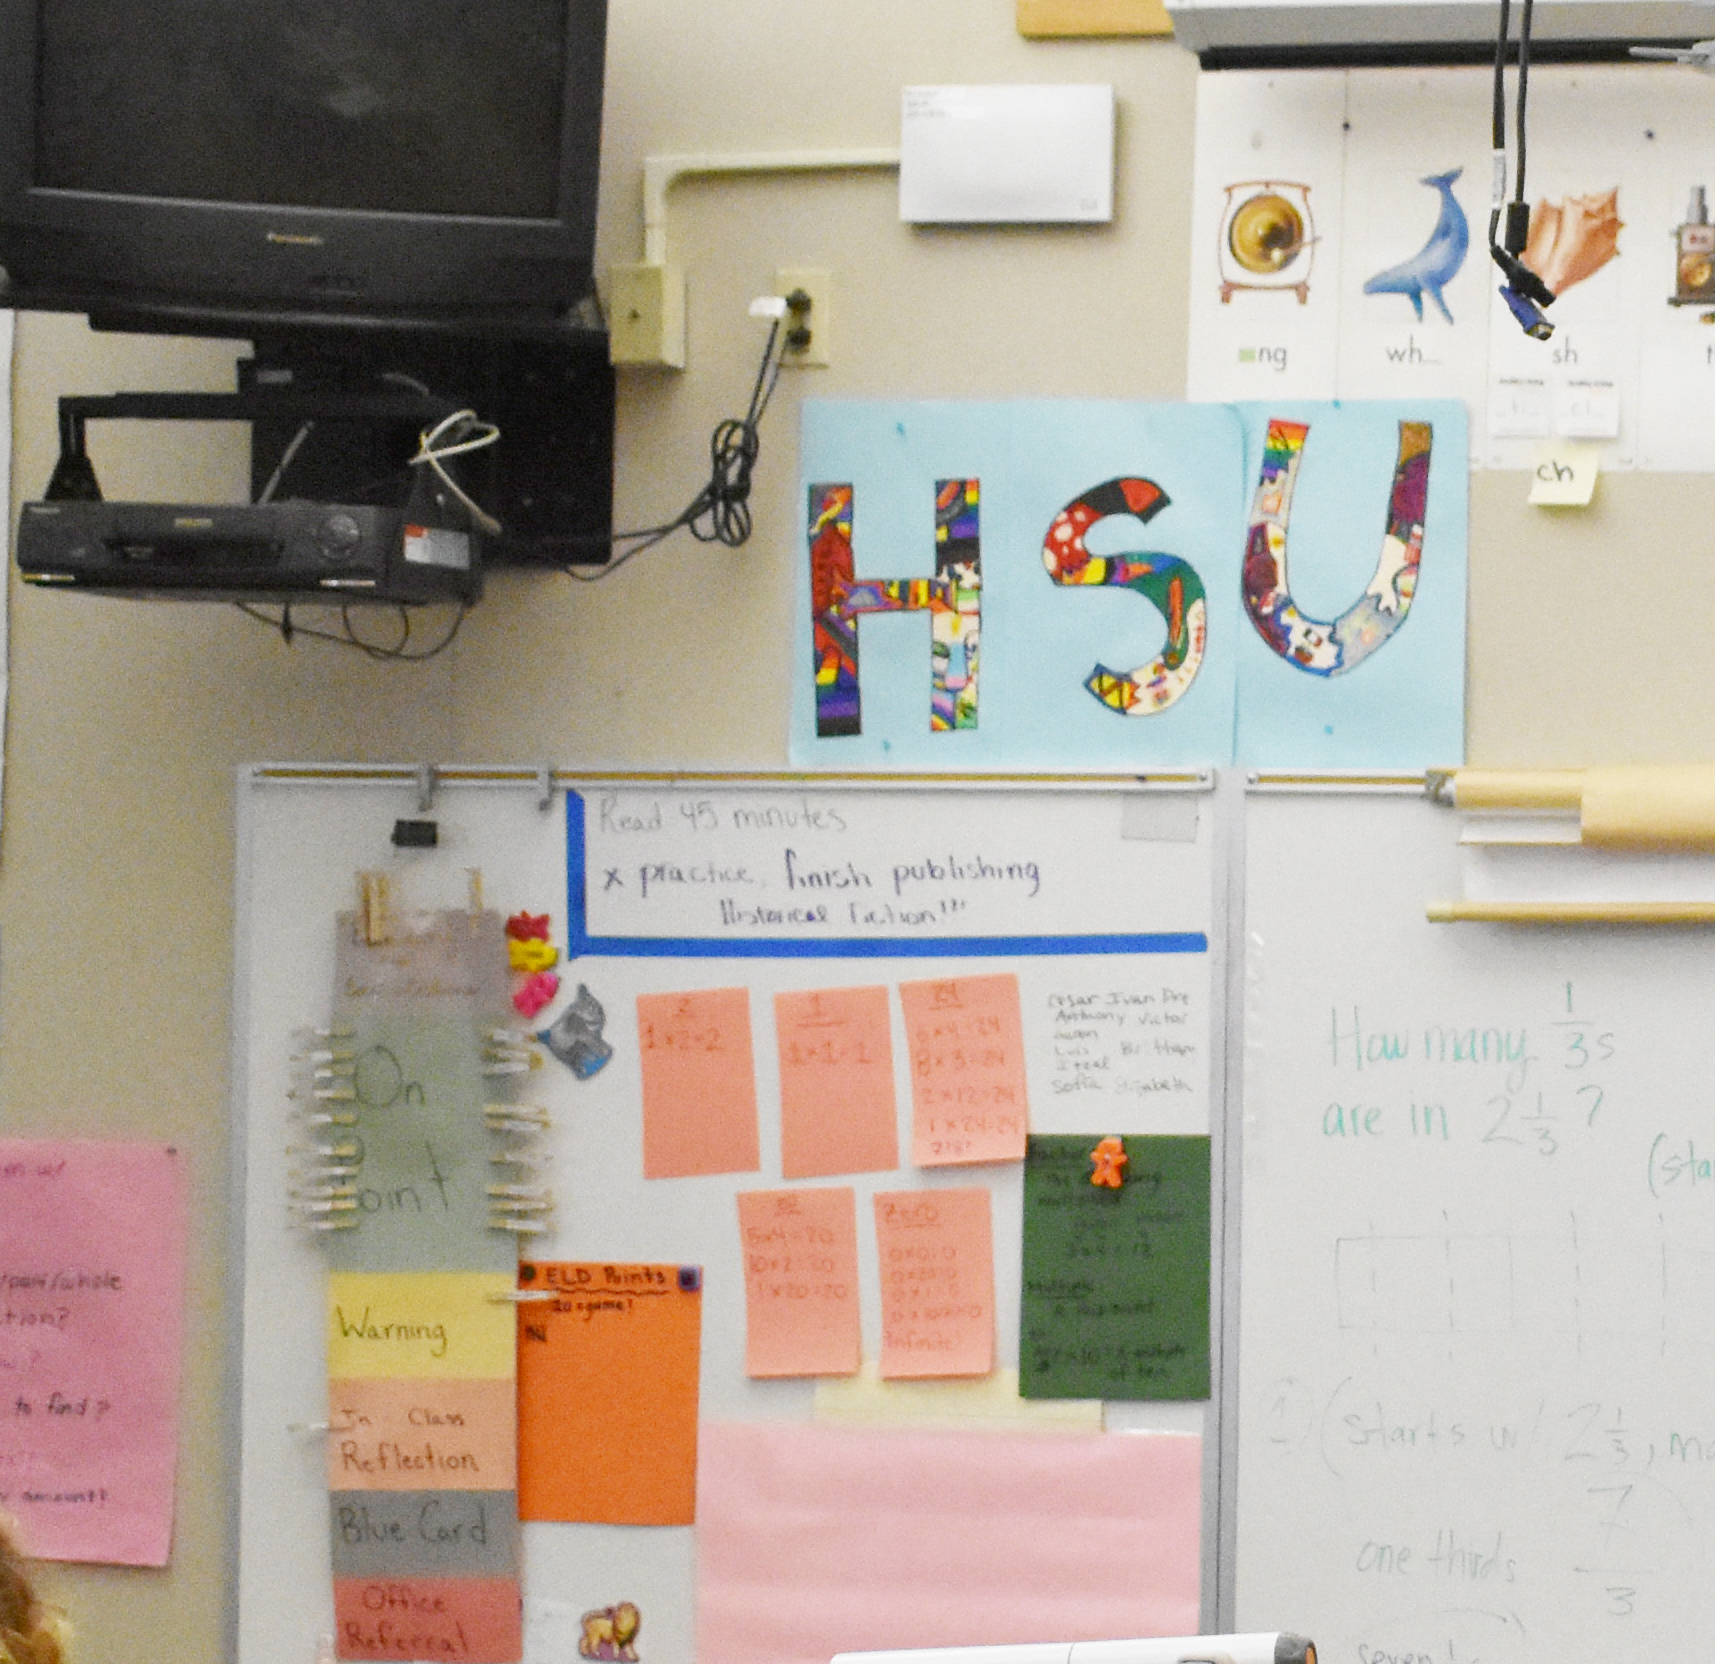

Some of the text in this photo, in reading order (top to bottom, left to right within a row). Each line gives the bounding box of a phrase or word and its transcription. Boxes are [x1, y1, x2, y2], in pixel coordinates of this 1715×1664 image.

[1552, 342, 1578, 366] sh
[1536, 460, 1576, 484] ch
[602, 797, 847, 834] Read 45 minutes
[785, 848, 873, 890] finish
[894, 854, 1042, 897] publishing
[1328, 1004, 1409, 1071] How
[1424, 1026, 1530, 1093] many
[355, 1045, 425, 1107] On
[1322, 1100, 1384, 1138] are
[1410, 1098, 1450, 1139] in
[547, 1266, 666, 1287] ELD Points
[336, 1306, 447, 1357] Warning
[408, 1406, 466, 1428] Class
[341, 1441, 480, 1474] Reflection
[338, 1500, 487, 1546] Blue Card
[1356, 1539, 1412, 1574] one
[361, 1584, 446, 1613] Office
[346, 1620, 470, 1655] Referral
